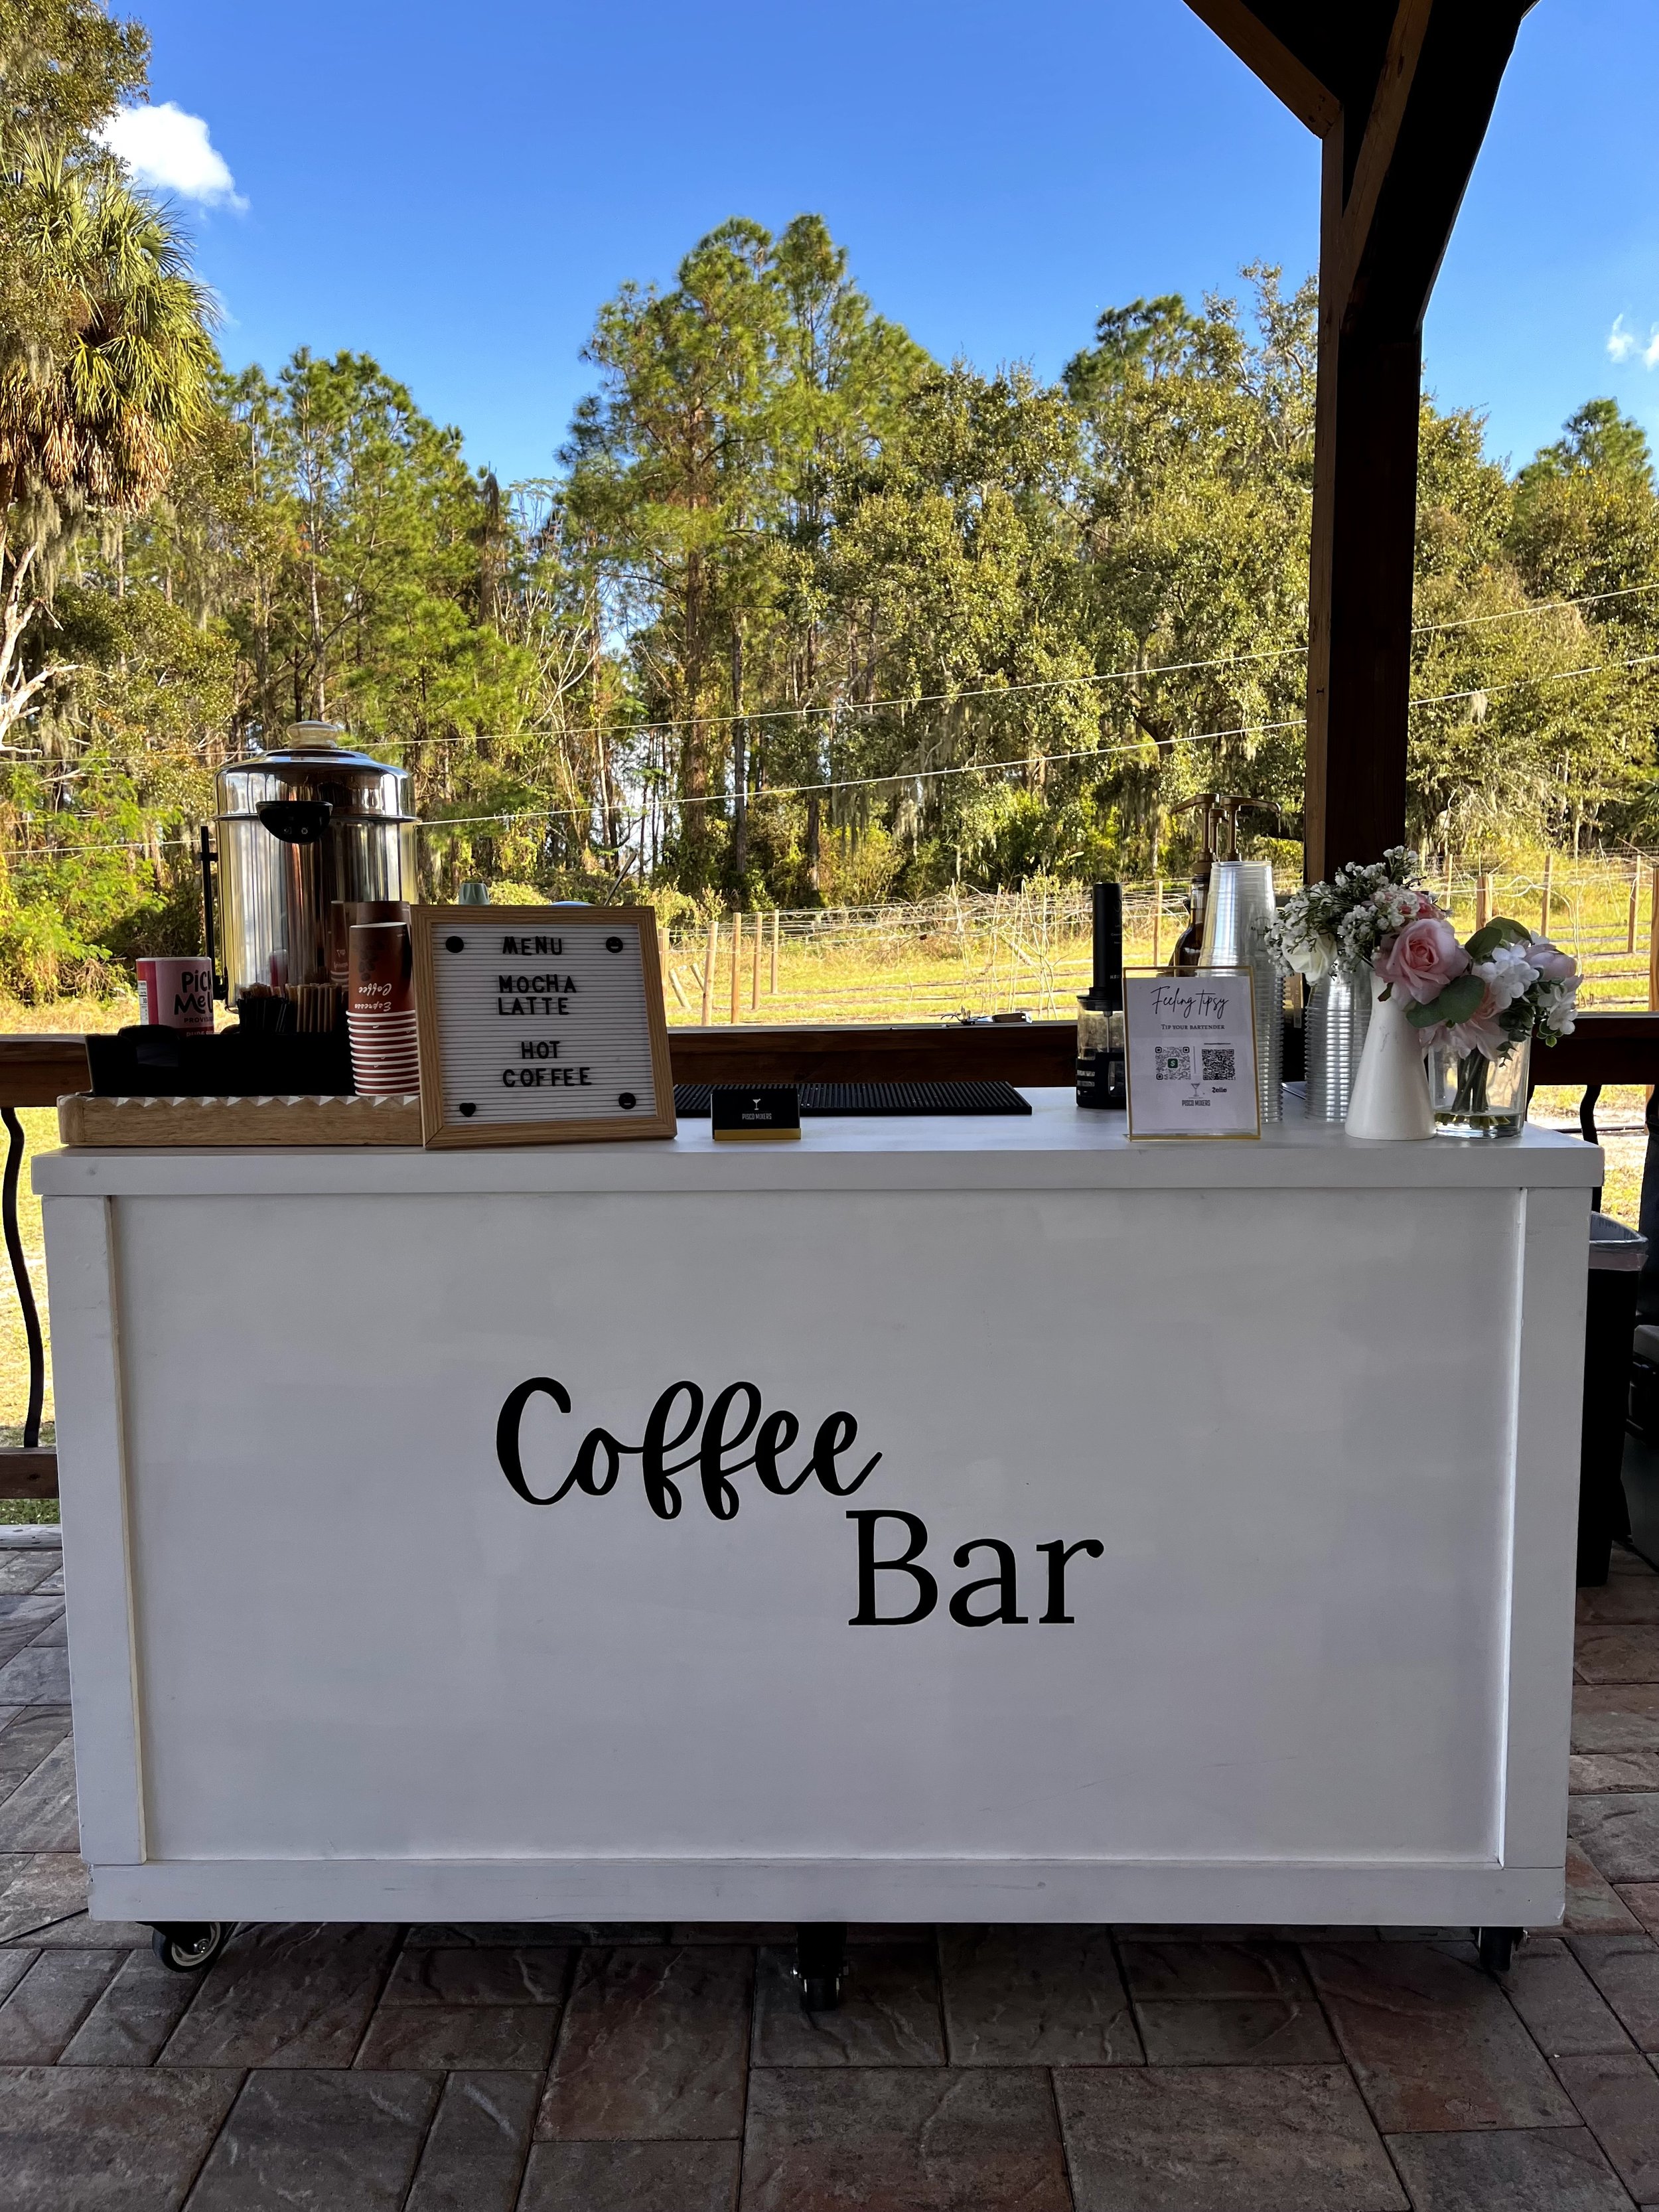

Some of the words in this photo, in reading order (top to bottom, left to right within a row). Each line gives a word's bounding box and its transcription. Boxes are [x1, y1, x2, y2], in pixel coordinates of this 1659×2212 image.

[502, 936, 563, 956] MENU
[358, 983, 392, 996] Coffee
[498, 974, 577, 994] MOCHA
[354, 1001, 392, 1012] Espresso
[498, 997, 569, 1015] LATTE
[1150, 986, 1196, 1019] Feeling
[521, 1041, 560, 1059] HOT
[502, 1067, 592, 1088] COFFEE
[496, 1377, 883, 1520] Coffee
[846, 1509, 1104, 1627] Bar
